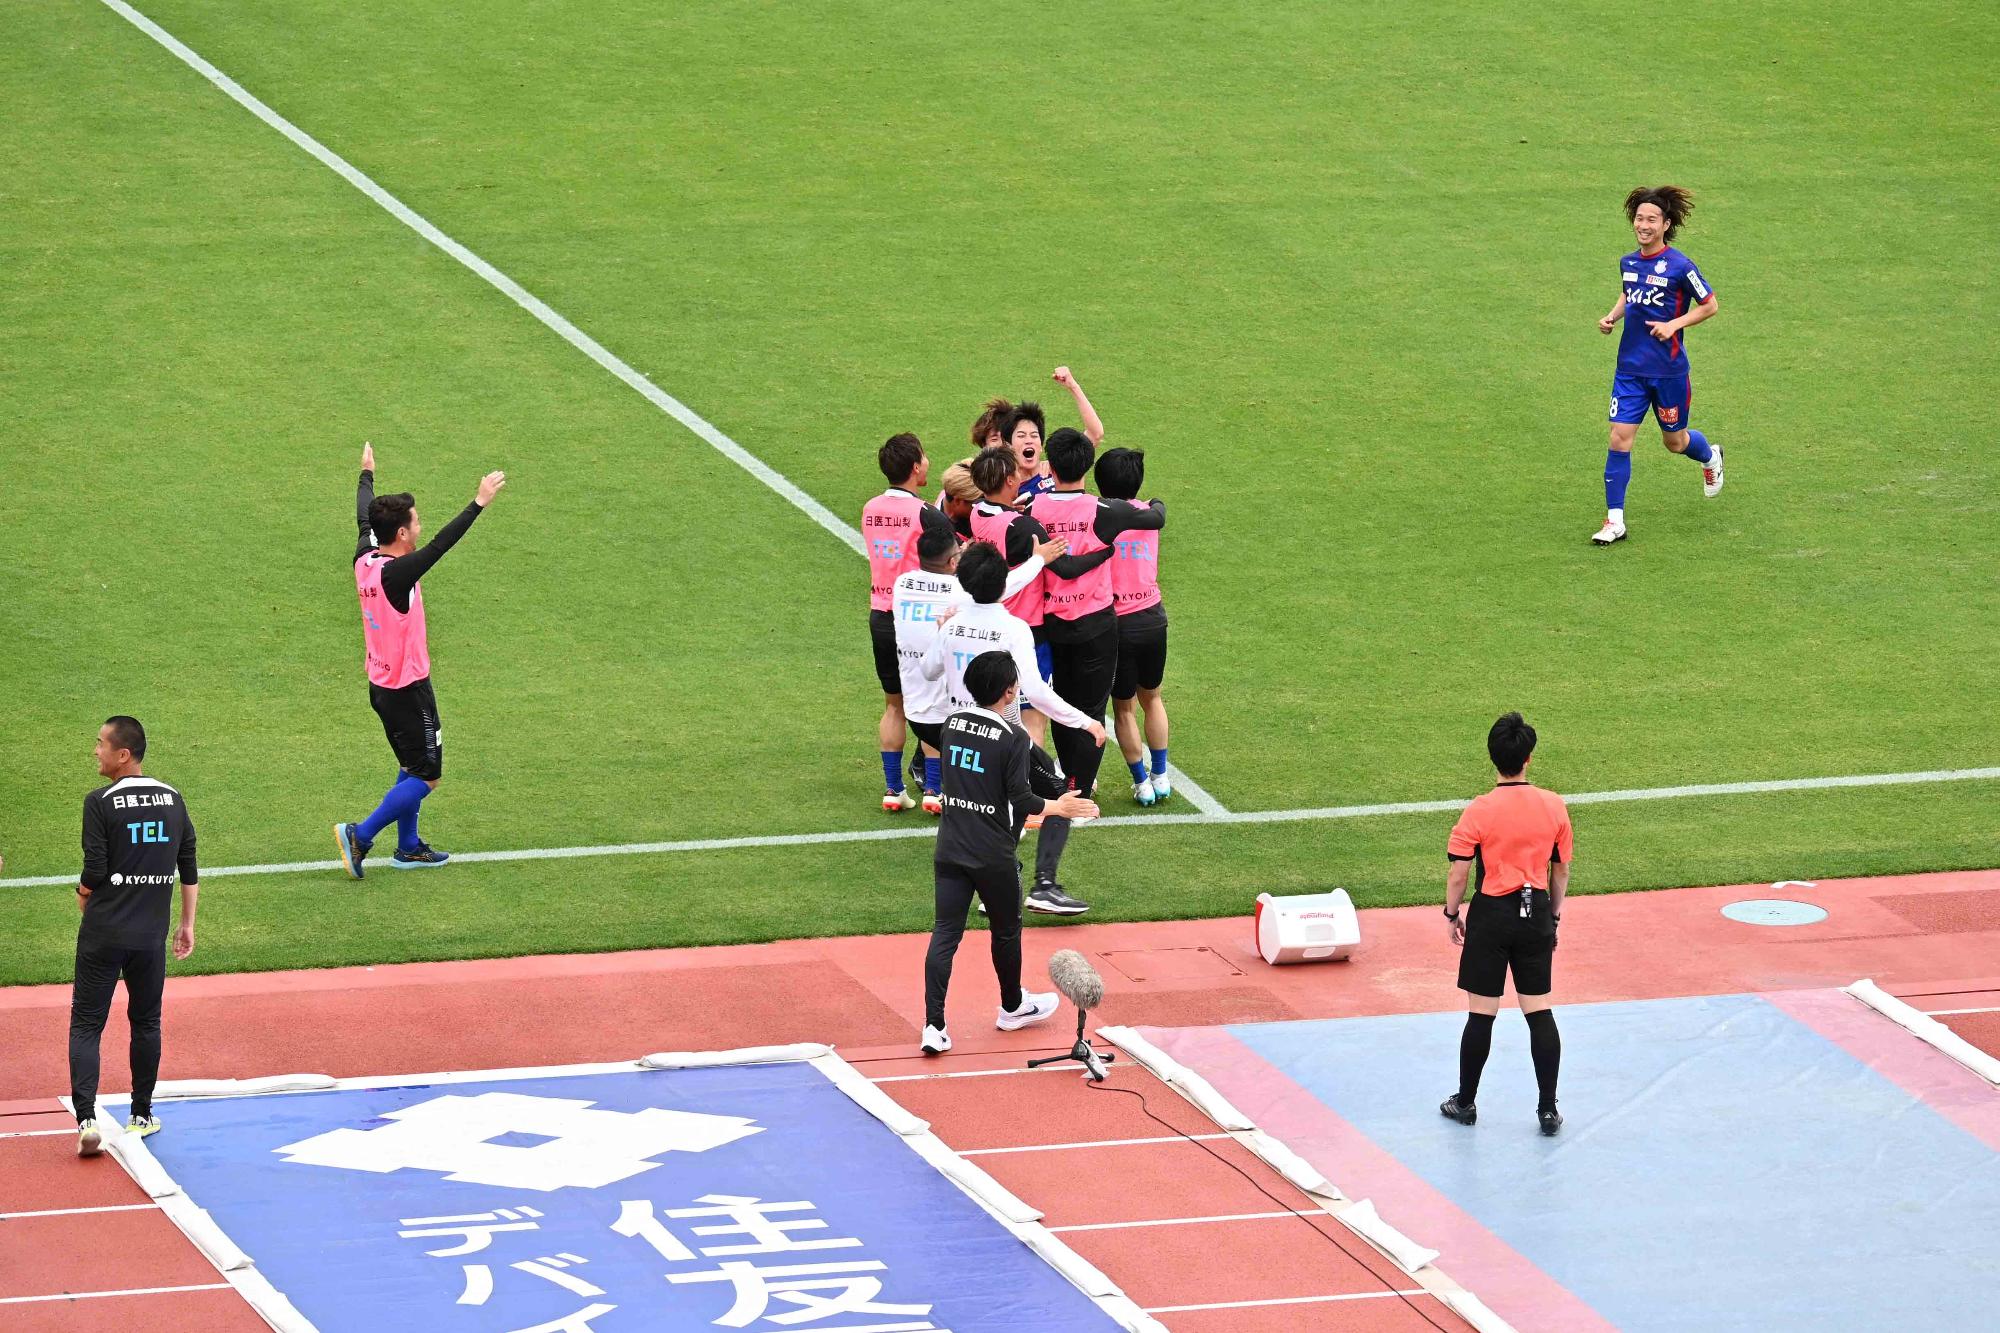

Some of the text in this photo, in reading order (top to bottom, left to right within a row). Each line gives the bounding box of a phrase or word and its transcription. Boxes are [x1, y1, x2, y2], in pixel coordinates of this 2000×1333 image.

[1609, 396, 1619, 418] 8
[865, 515, 911, 528] 日医工山梨
[1045, 521, 1089, 534] 医工山梨
[873, 539, 904, 559] TEL
[1122, 589, 1155, 601] KYOKU
[900, 600, 937, 622] TEL
[948, 717, 1003, 741] 日医工山梨
[949, 745, 985, 774] TEL
[113, 793, 174, 809] 日医工山梨
[949, 797, 996, 815] KYOKUYO
[127, 821, 169, 844] TEL
[125, 874, 174, 885] KYOKUYO
[609, 1194, 955, 1333] 住友
